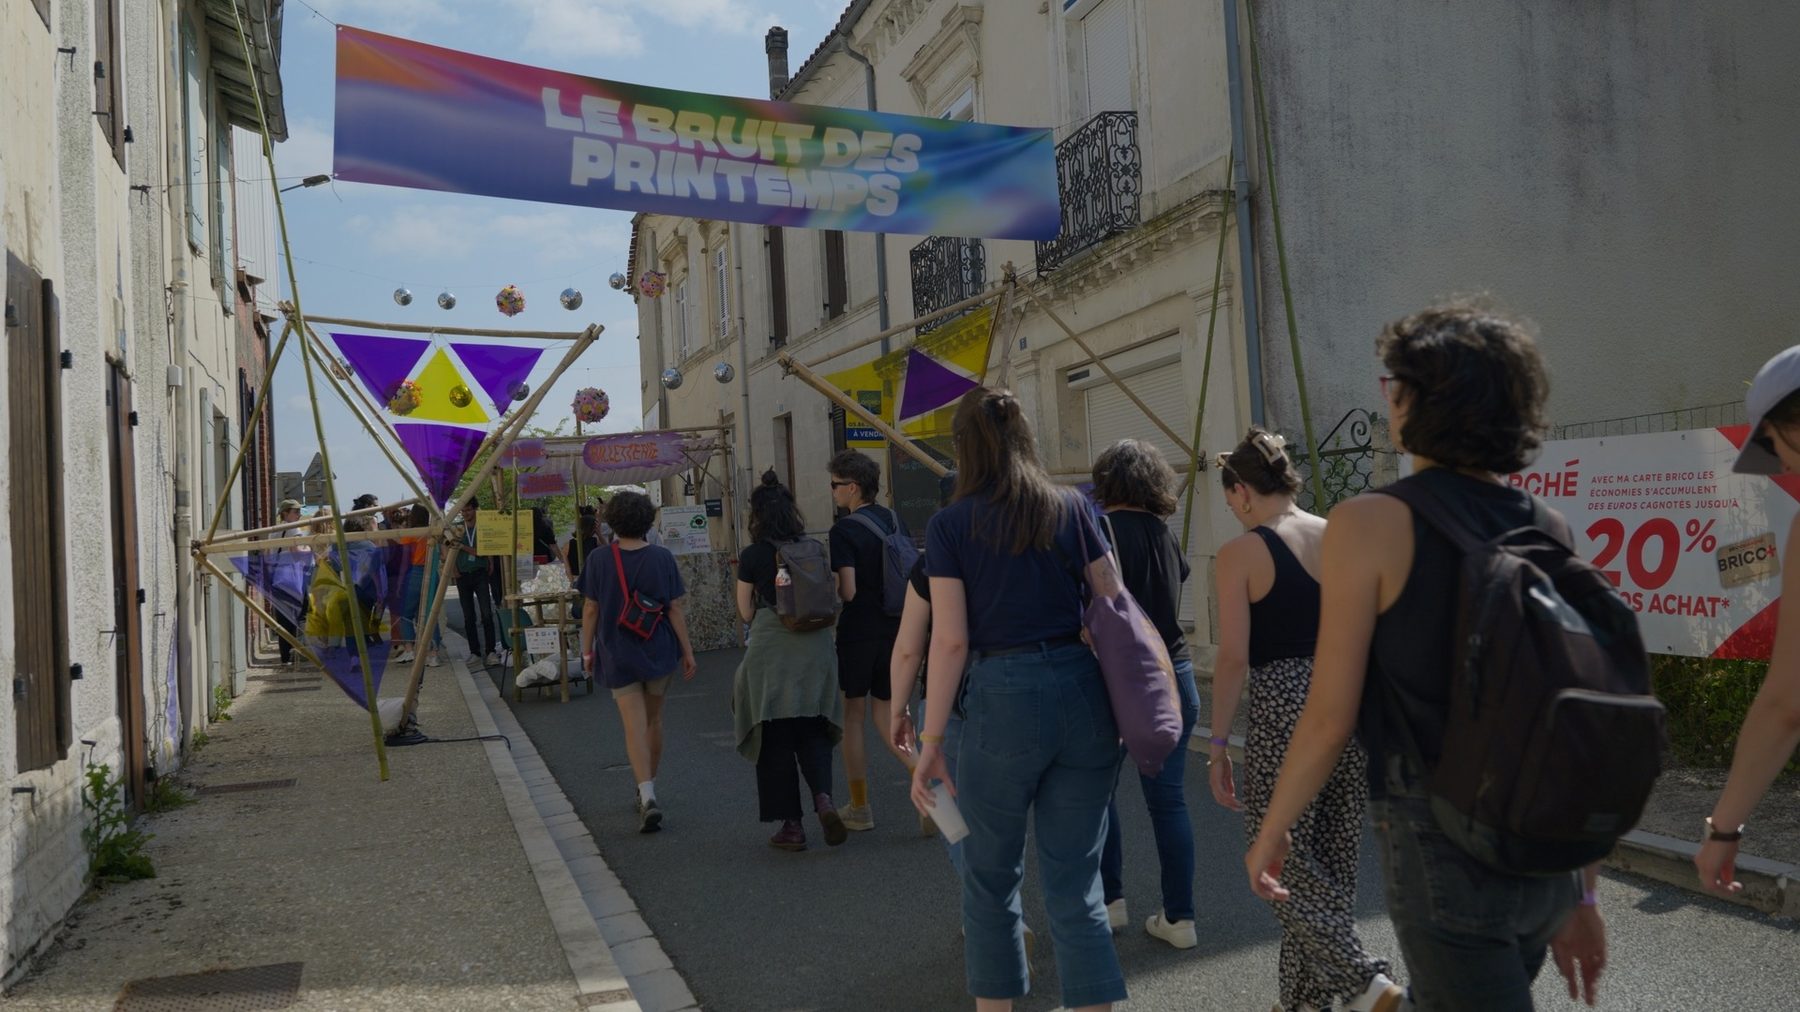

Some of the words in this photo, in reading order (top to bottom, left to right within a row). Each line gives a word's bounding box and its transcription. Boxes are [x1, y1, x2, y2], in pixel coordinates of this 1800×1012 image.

[542, 87, 623, 138] LE
[632, 104, 815, 163] BRUIT
[820, 127, 921, 172] DES
[571, 136, 901, 216] PRINTEMPS
[1508, 459, 1579, 497] RCHÉ
[1591, 475, 1614, 484] AVEC
[1616, 474, 1630, 483] MA
[1633, 473, 1662, 483] CARTE
[1665, 472, 1694, 481] BRICO
[1697, 471, 1714, 480] LES
[1645, 485, 1717, 496] S'ACCUMULENT
[1588, 502, 1605, 511] DES
[1607, 501, 1637, 510] EUROS
